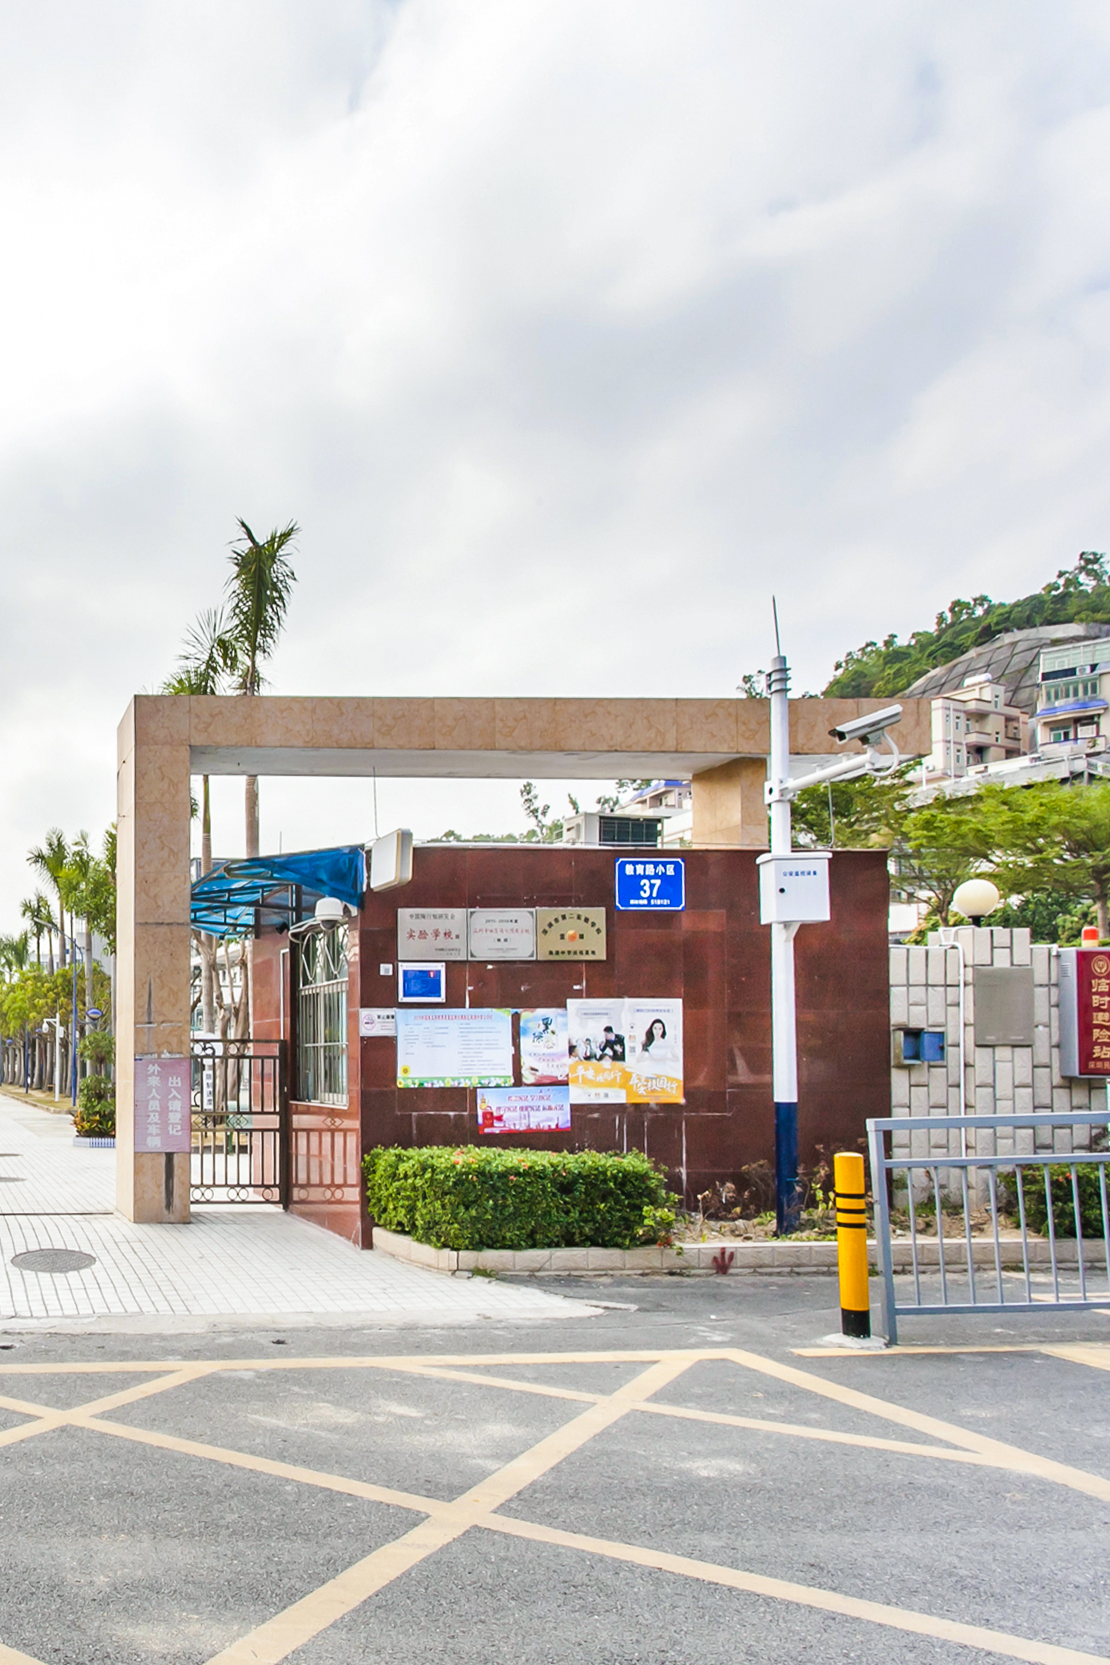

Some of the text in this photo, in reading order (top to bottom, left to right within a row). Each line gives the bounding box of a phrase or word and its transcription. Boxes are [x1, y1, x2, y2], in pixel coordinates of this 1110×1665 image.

[625, 864, 675, 876] 教育路小区
[639, 879, 661, 898] 37
[406, 928, 454, 941] 实验学校
[541, 913, 602, 936] 深圳市第二实验学校
[1091, 978, 1110, 1059] 临时避险站
[146, 1063, 162, 1148] 外来人员及车辆
[168, 1076, 182, 1136] 出入请登记
